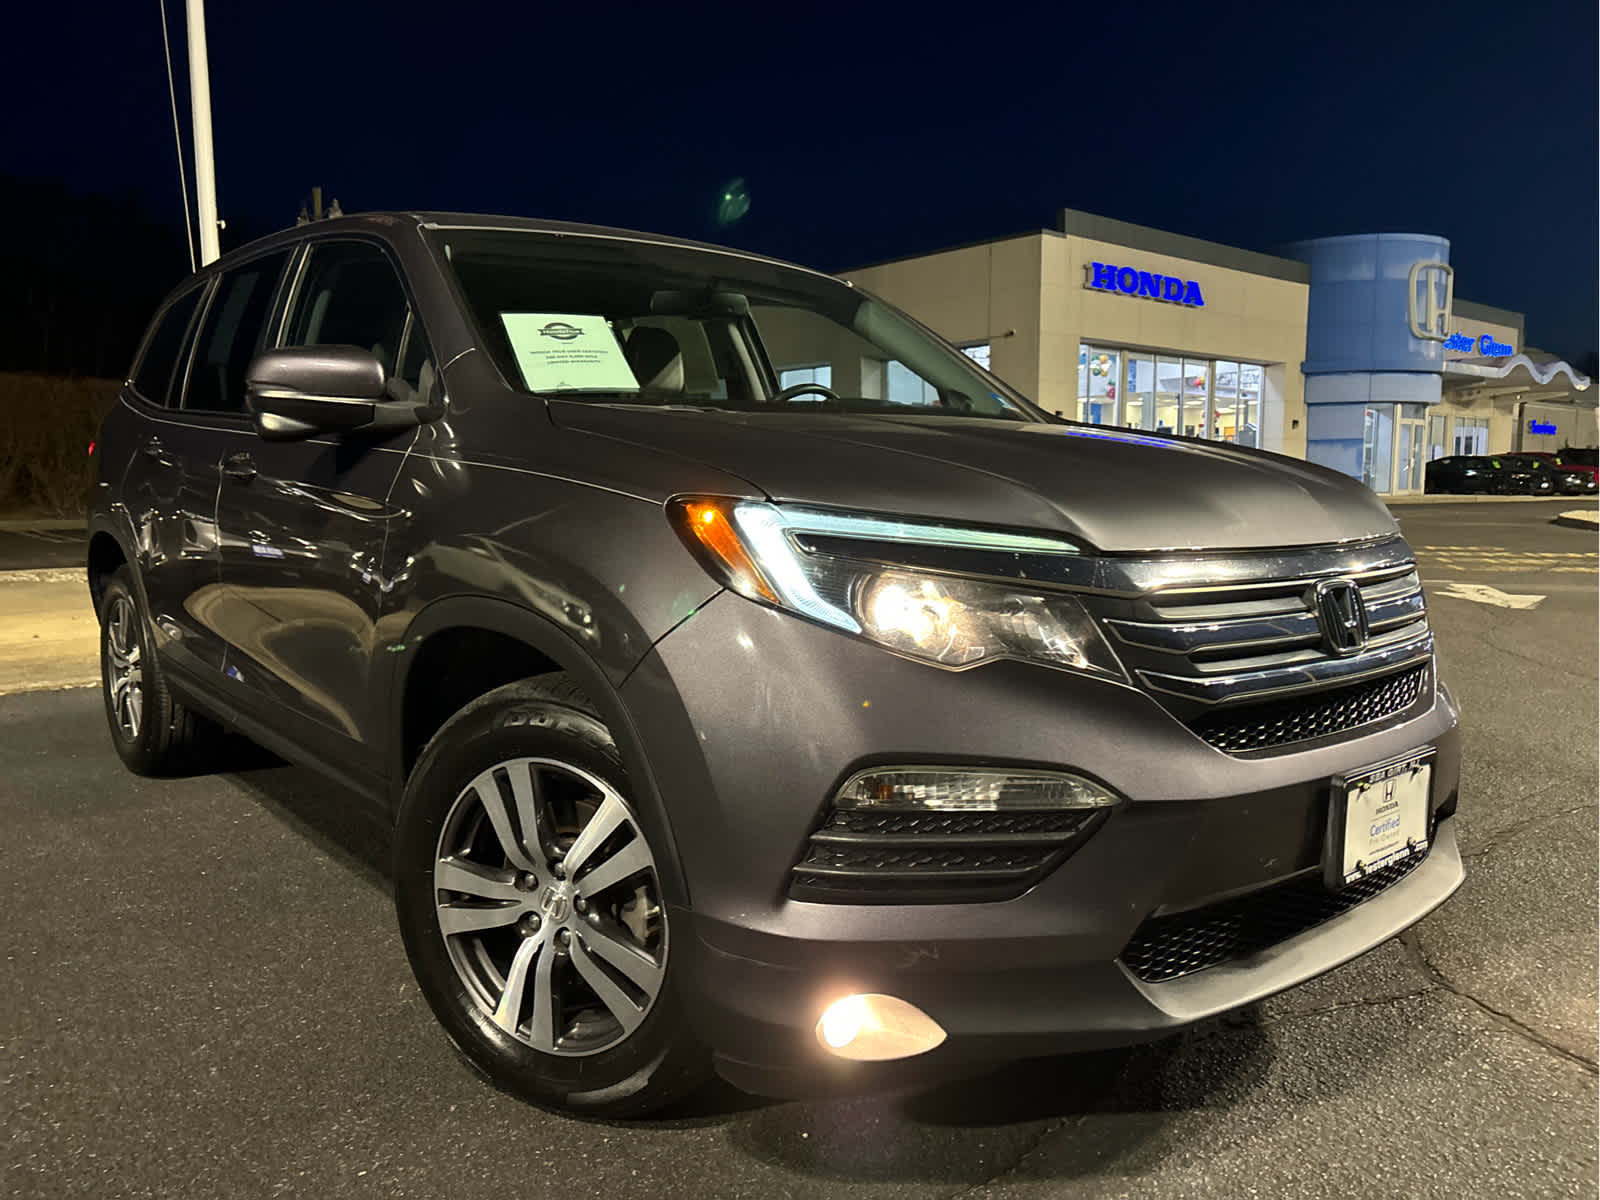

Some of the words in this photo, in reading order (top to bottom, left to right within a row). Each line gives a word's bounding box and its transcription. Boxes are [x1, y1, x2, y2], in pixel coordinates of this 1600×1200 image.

[1087, 262, 1205, 306] HONDA
[1479, 333, 1514, 357] Glenn
[1375, 800, 1399, 815] HONDA
[1369, 815, 1401, 837] Certified
